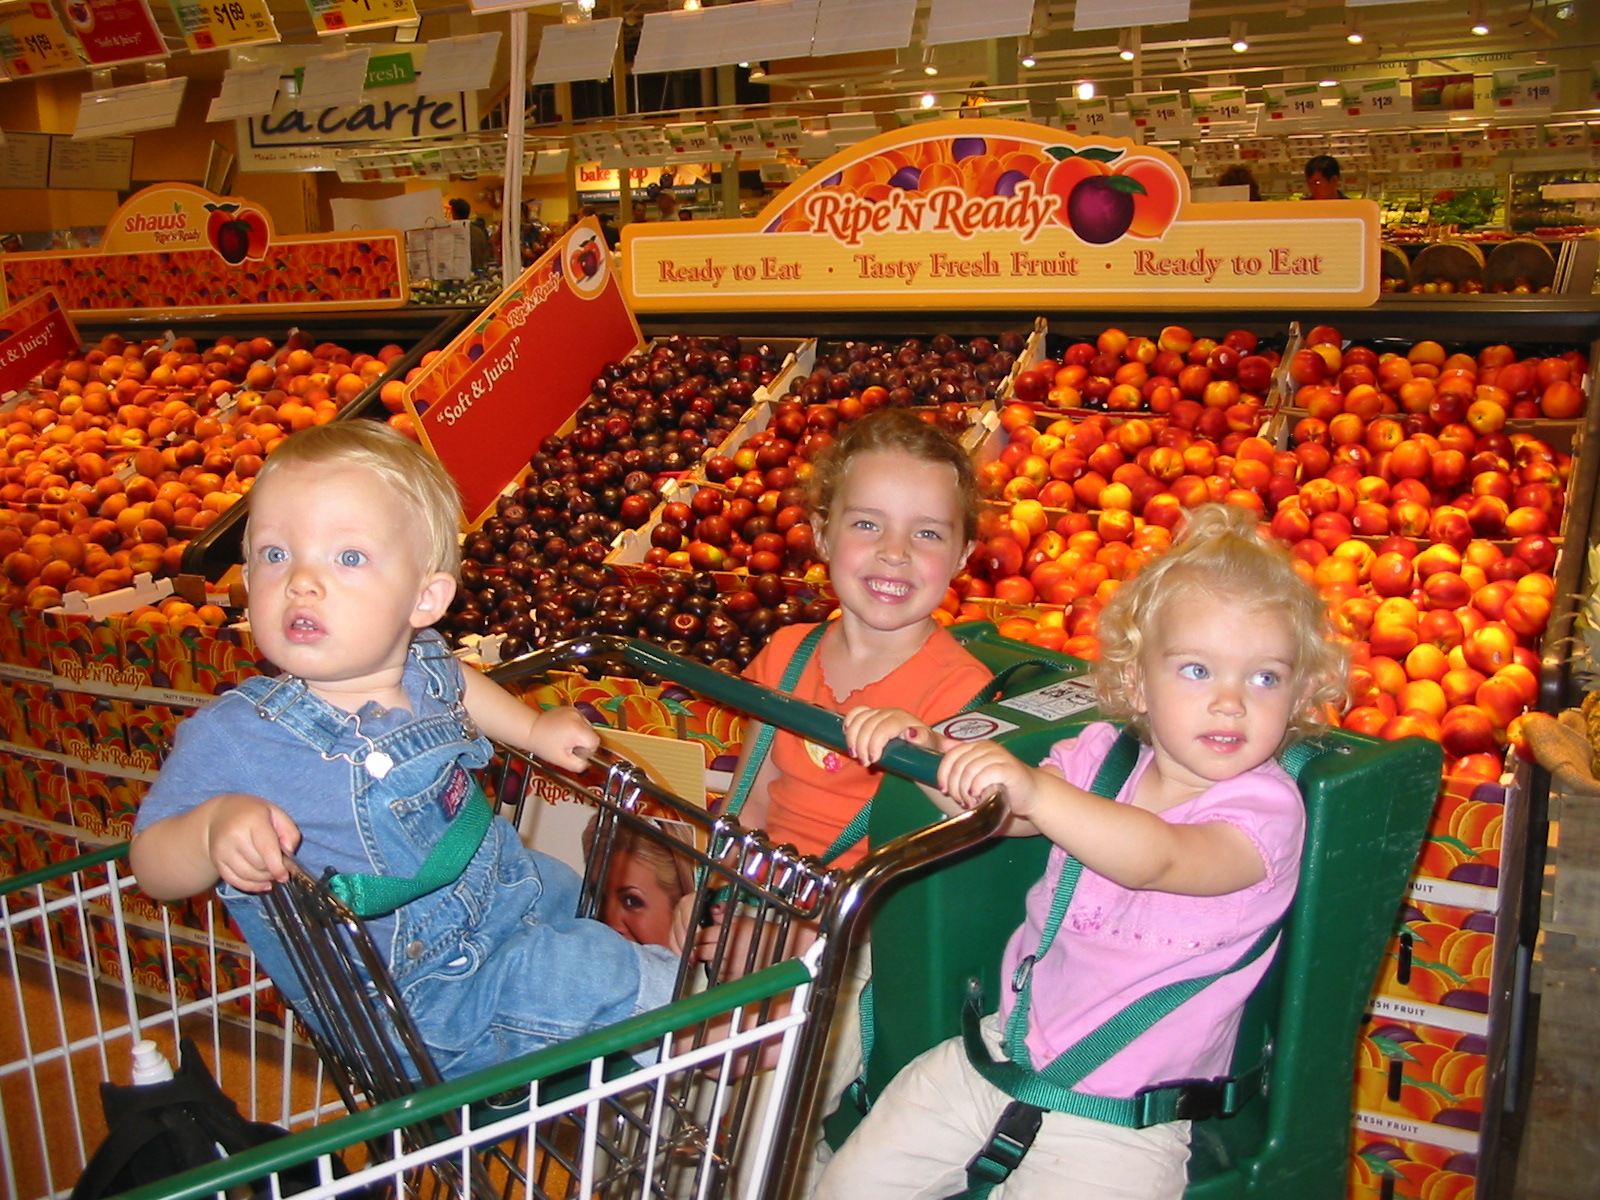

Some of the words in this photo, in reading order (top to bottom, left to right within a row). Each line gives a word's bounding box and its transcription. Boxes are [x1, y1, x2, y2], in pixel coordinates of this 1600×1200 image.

[365, 63, 406, 82] resh
[580, 166, 610, 182] bake
[930, 185, 1057, 241] Ready
[658, 256, 726, 287] Ready
[733, 261, 756, 280] to
[761, 256, 802, 280] Eat
[854, 253, 921, 285] Tasty
[930, 251, 1000, 277] Fresh
[1010, 250, 1079, 276] Fruit
[1134, 248, 1224, 282] Ready
[1231, 254, 1263, 275] to
[1268, 248, 1323, 275] Eat
[533, 272, 561, 304] Ready
[7, 349, 20, 362] &
[471, 378, 486, 401] &
[103, 663, 144, 691] Ready
[110, 746, 152, 774] Ready
[1393, 1003, 1426, 1016] FRUIT
[1386, 1120, 1419, 1134] FRUIT
